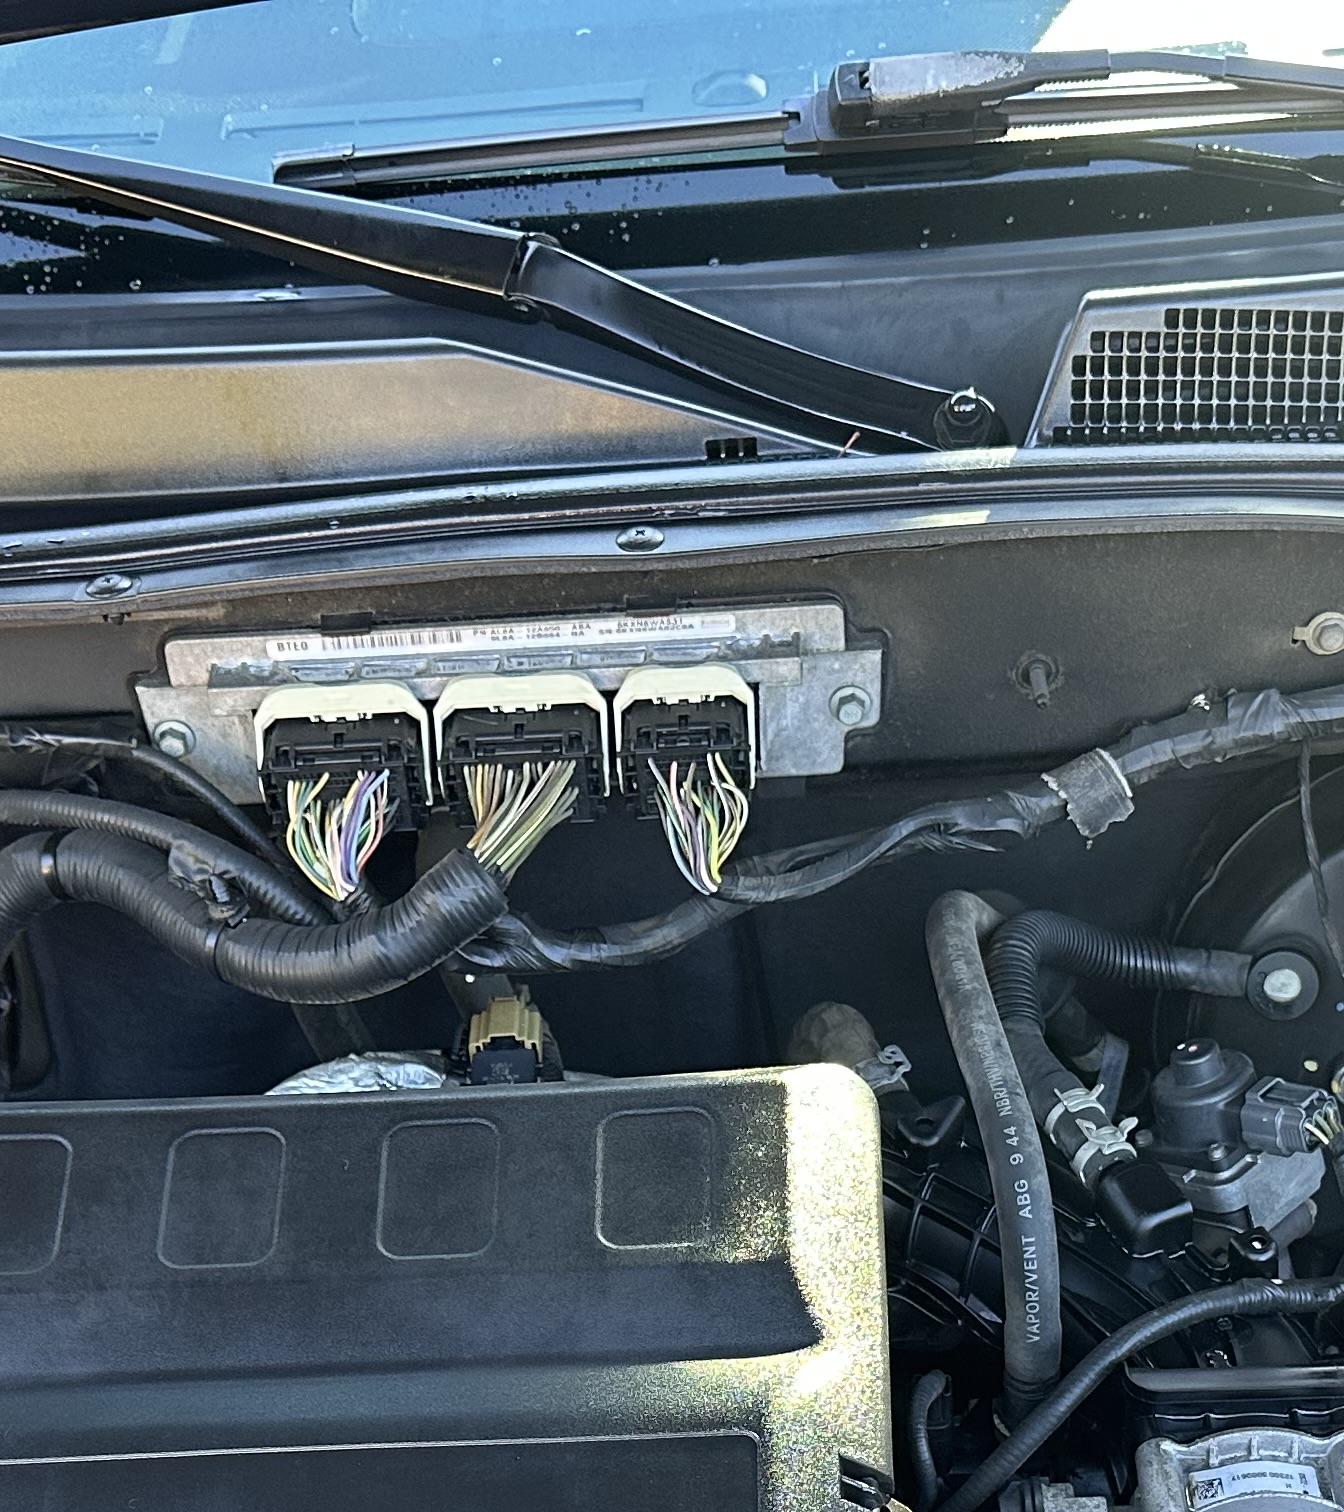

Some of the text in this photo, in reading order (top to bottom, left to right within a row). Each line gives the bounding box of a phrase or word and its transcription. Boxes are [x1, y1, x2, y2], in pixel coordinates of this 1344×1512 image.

[1002, 1125, 1019, 1147] 44
[1008, 1153, 1023, 1166] 9
[1013, 1178, 1032, 1219] ABG
[1021, 1233, 1042, 1343] VAPOR/VENT
